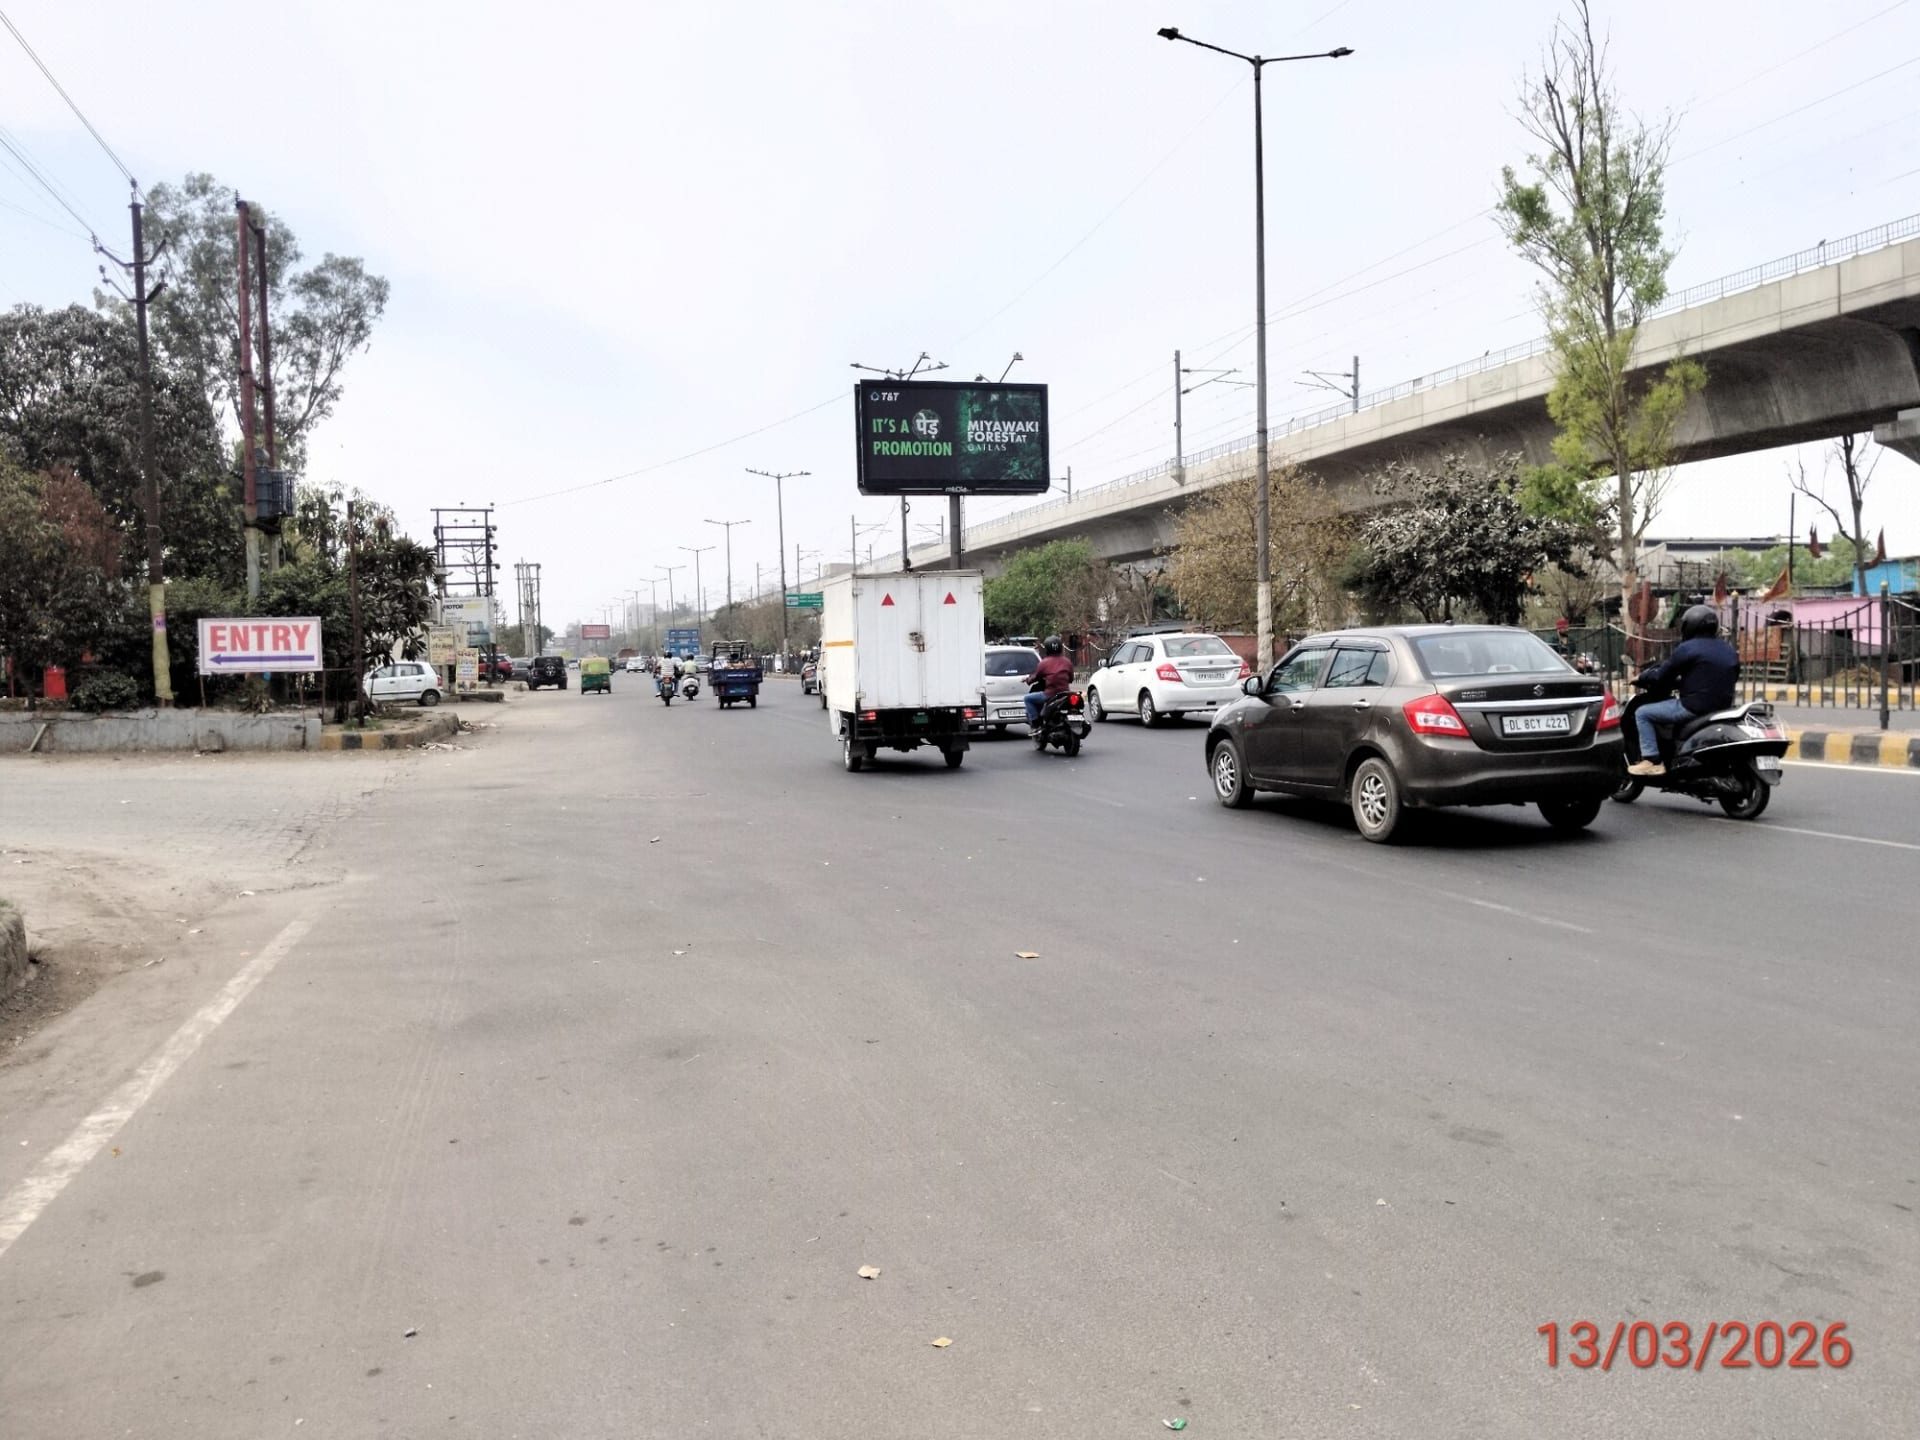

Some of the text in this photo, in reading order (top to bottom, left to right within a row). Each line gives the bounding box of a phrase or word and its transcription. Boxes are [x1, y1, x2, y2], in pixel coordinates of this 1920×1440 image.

[881, 392, 900, 401] T&T
[872, 412, 939, 439] IT'S A पेड़
[967, 420, 1039, 432] MIYAWAKI
[967, 431, 1027, 443] FOREST AT
[873, 441, 953, 456] PROMOTION
[210, 624, 311, 652] ENTRY
[1509, 719, 1521, 730] DL
[1545, 717, 1568, 729] 4221
